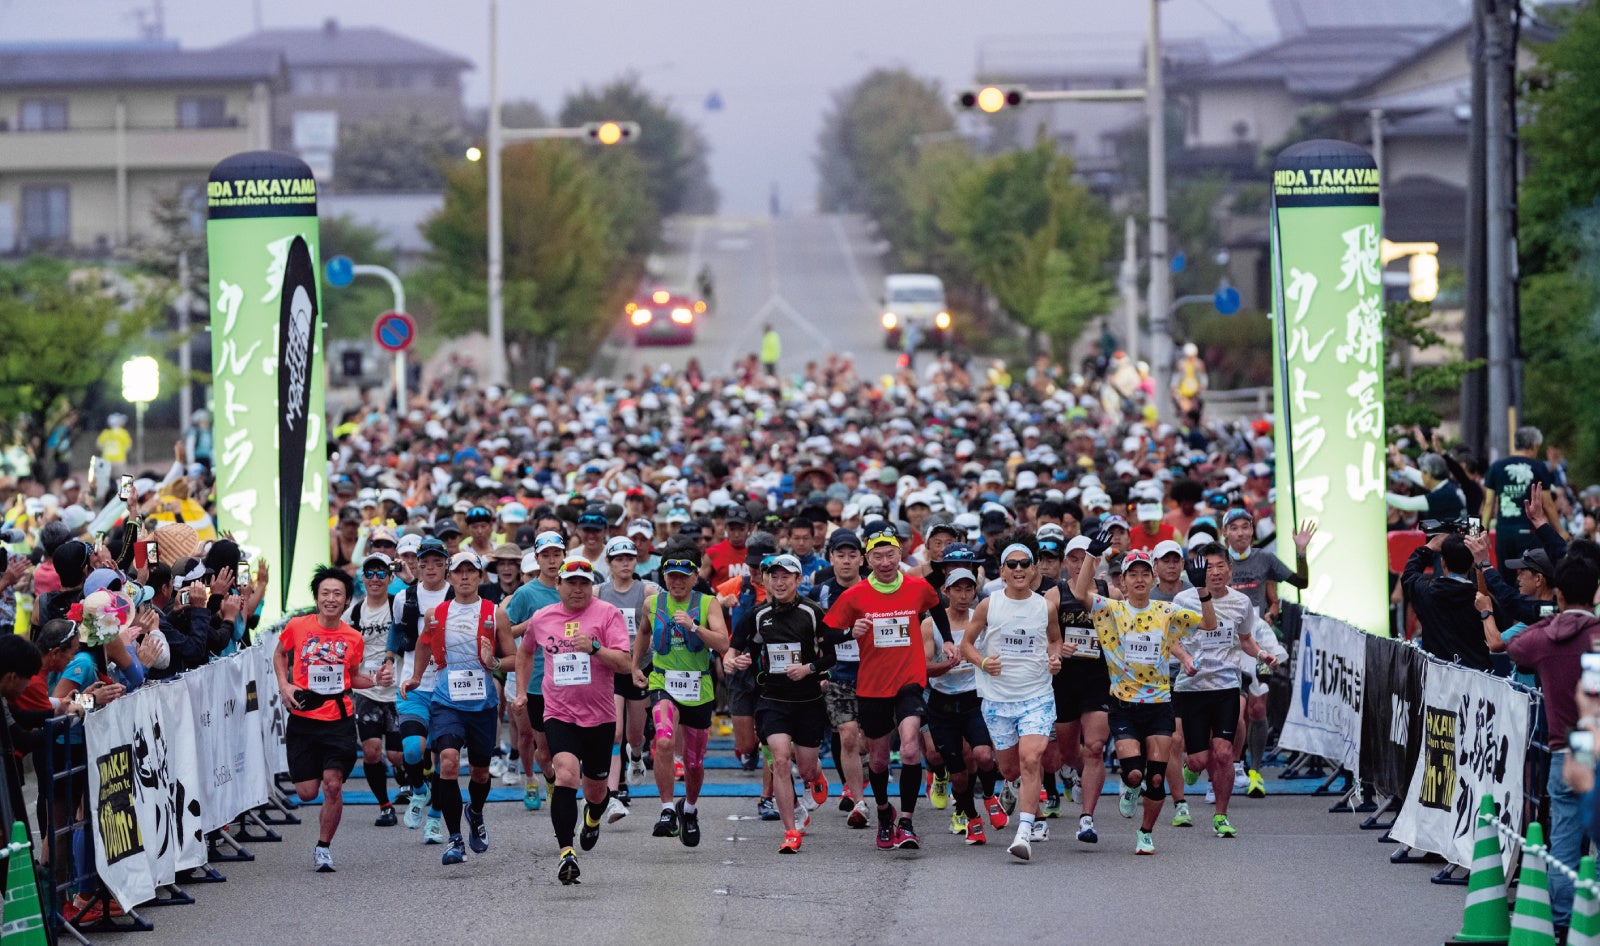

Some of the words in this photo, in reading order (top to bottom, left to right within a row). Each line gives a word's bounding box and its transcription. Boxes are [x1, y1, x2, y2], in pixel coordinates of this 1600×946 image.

[1274, 169, 1307, 186] HIDA
[1309, 168, 1379, 185] TAKAYAM
[1293, 185, 1344, 195] marathon
[881, 628, 893, 636] 123
[1069, 637, 1087, 645] 1103
[1130, 644, 1148, 652] 1120
[558, 665, 574, 673] 1675
[313, 675, 330, 683] 1891
